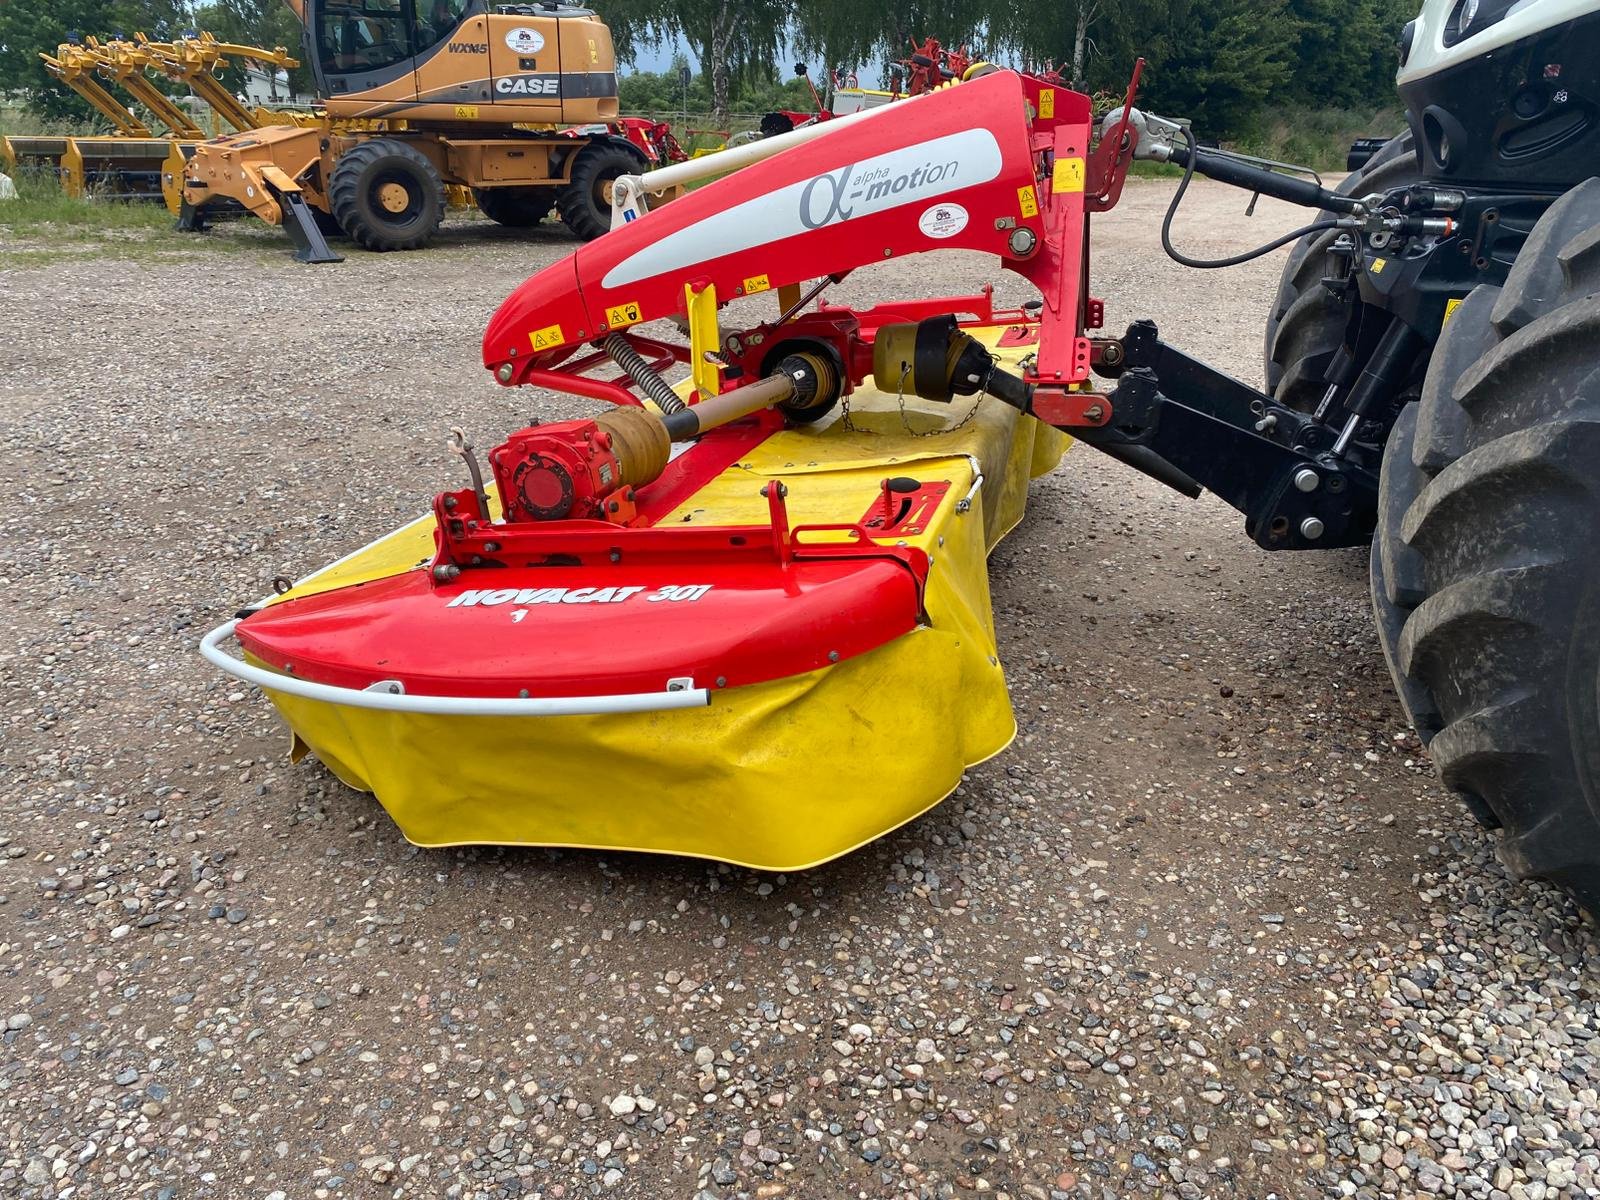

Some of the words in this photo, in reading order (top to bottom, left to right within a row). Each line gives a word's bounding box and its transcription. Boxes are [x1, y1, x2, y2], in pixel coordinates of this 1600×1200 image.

[495, 77, 559, 94] CASE
[853, 167, 890, 187] alpha
[445, 586, 646, 608] NOVACAT
[647, 584, 713, 602] 301
